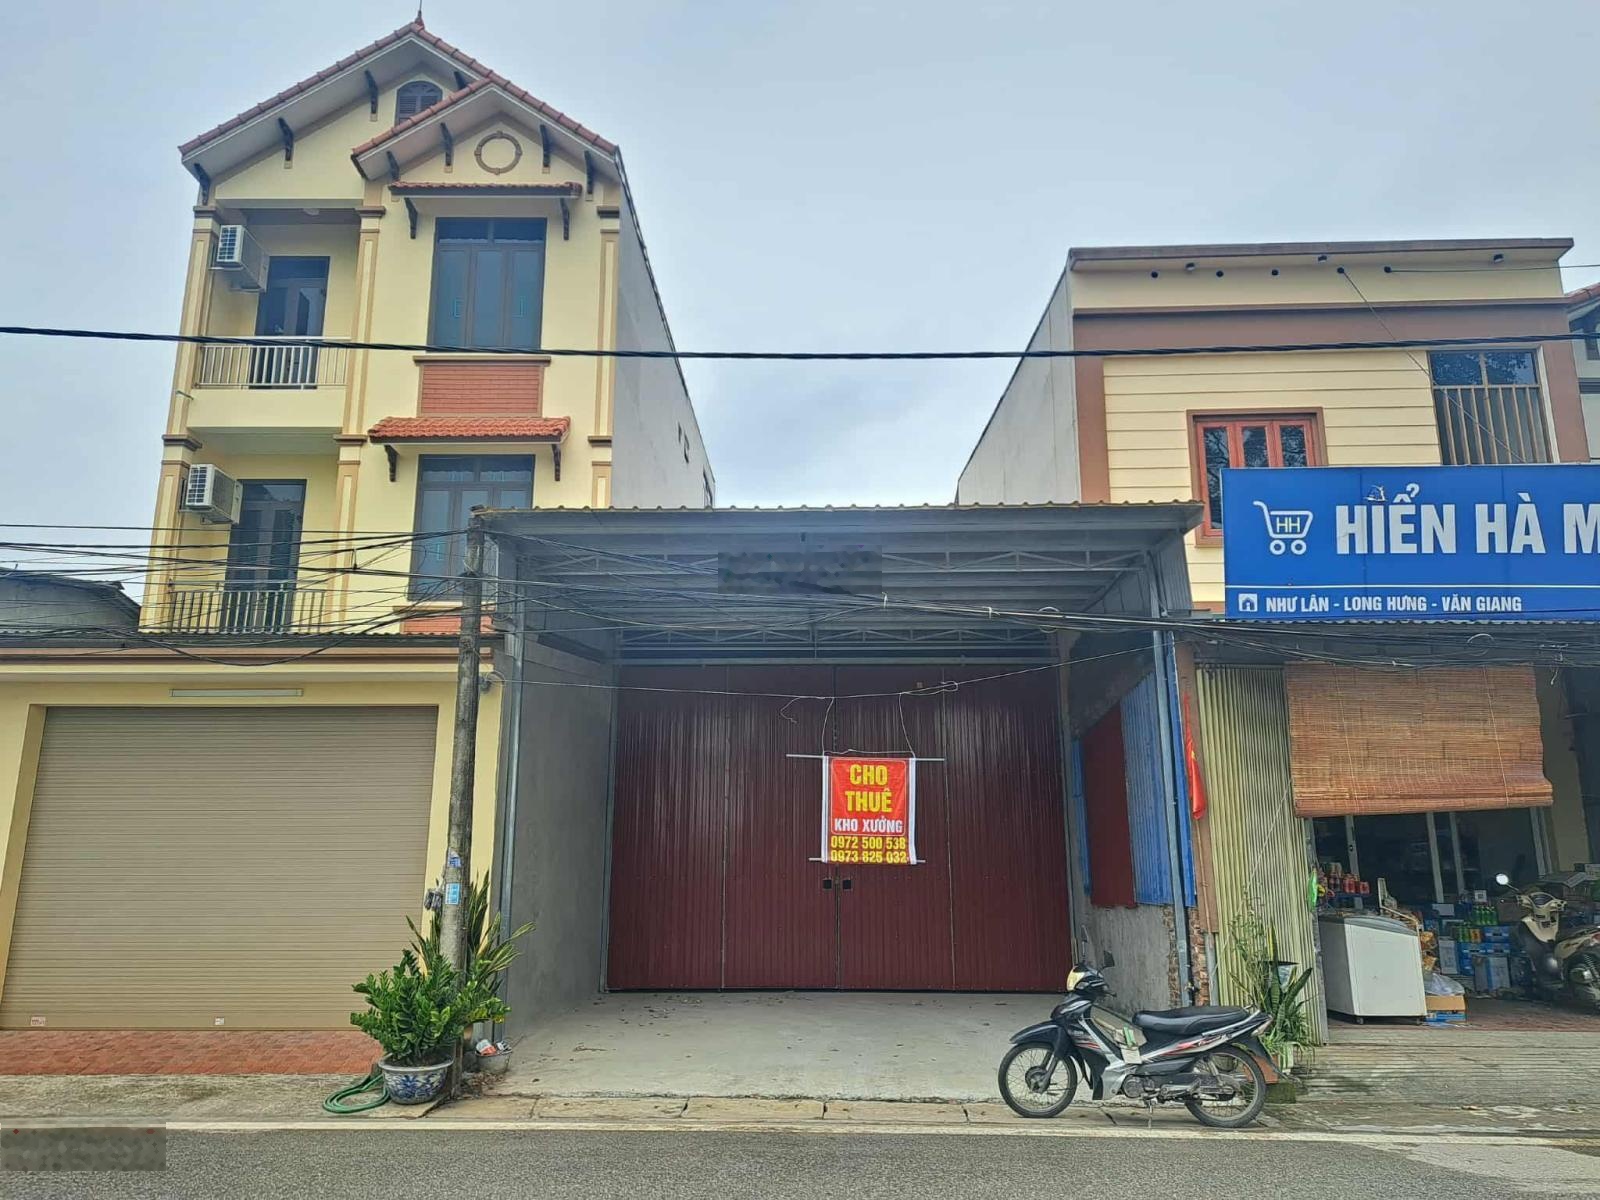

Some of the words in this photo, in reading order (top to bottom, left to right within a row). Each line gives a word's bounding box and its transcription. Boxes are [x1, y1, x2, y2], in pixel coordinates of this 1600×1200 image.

[1276, 516, 1301, 533] HH
[1335, 482, 1457, 555] HIỂN
[1475, 492, 1547, 555] HÀ
[1266, 596, 1299, 613] NHƯ
[1301, 594, 1329, 613] LÂN
[1344, 596, 1382, 611] LONG
[1386, 595, 1427, 612] HƯNG
[1441, 594, 1472, 612] VĂN
[1476, 596, 1522, 612] GIANG
[849, 764, 889, 786] CHO
[845, 788, 893, 813] THUÊ
[834, 818, 859, 832] KHO
[862, 815, 904, 833] XƯỞNG
[830, 835, 859, 849] 0972
[830, 850, 859, 863] 0973
